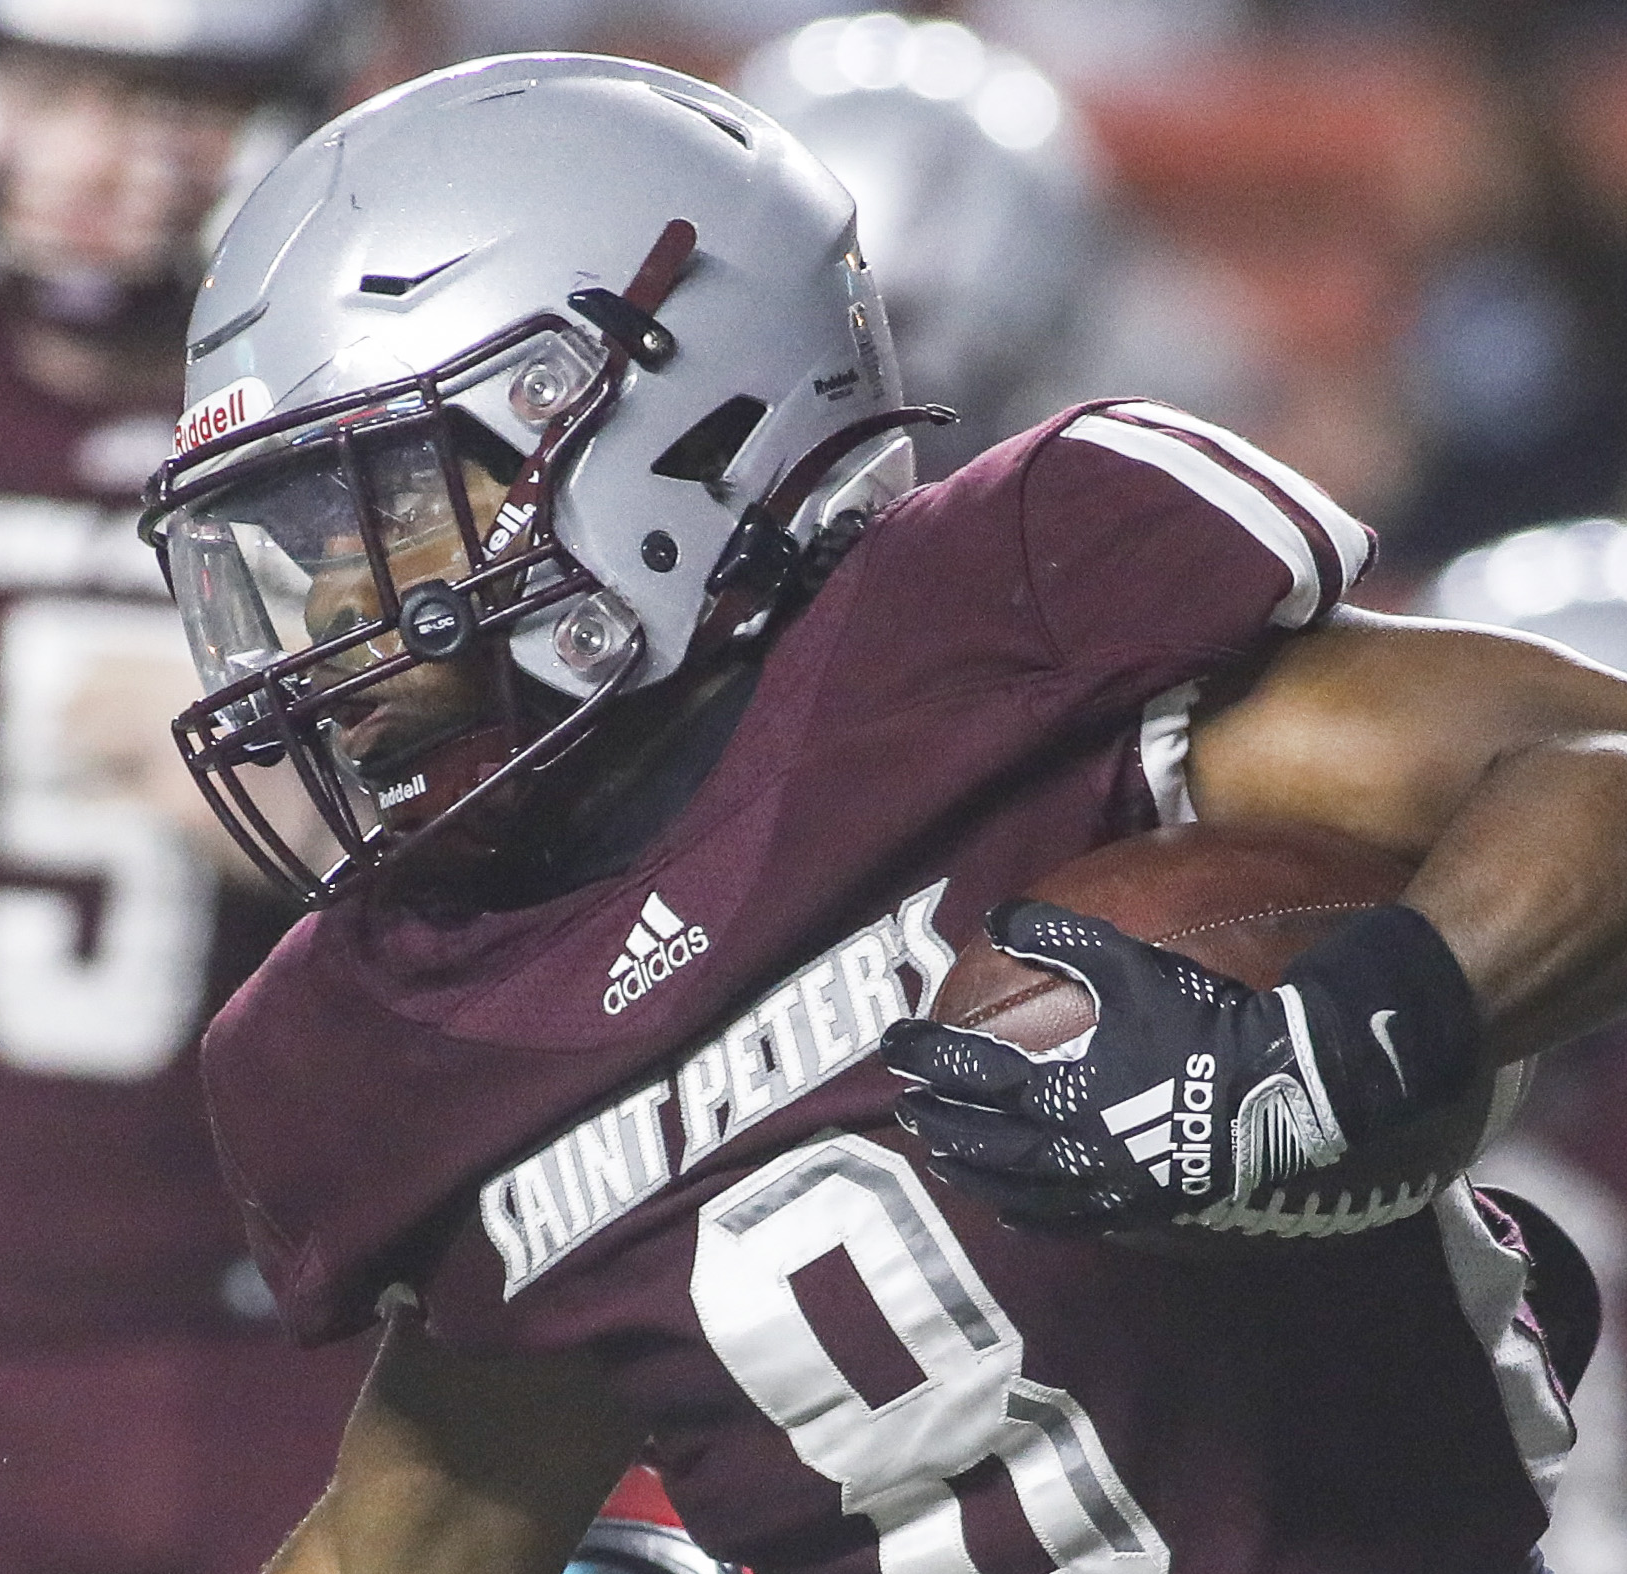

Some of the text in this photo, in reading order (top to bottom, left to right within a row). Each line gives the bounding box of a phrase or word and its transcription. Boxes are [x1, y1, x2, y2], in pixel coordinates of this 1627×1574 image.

[174, 388, 245, 456] Riddell
[603, 925, 710, 1015] adidas
[479, 877, 958, 1303] SAINT PETER'S
[1172, 1053, 1216, 1195] adidas
